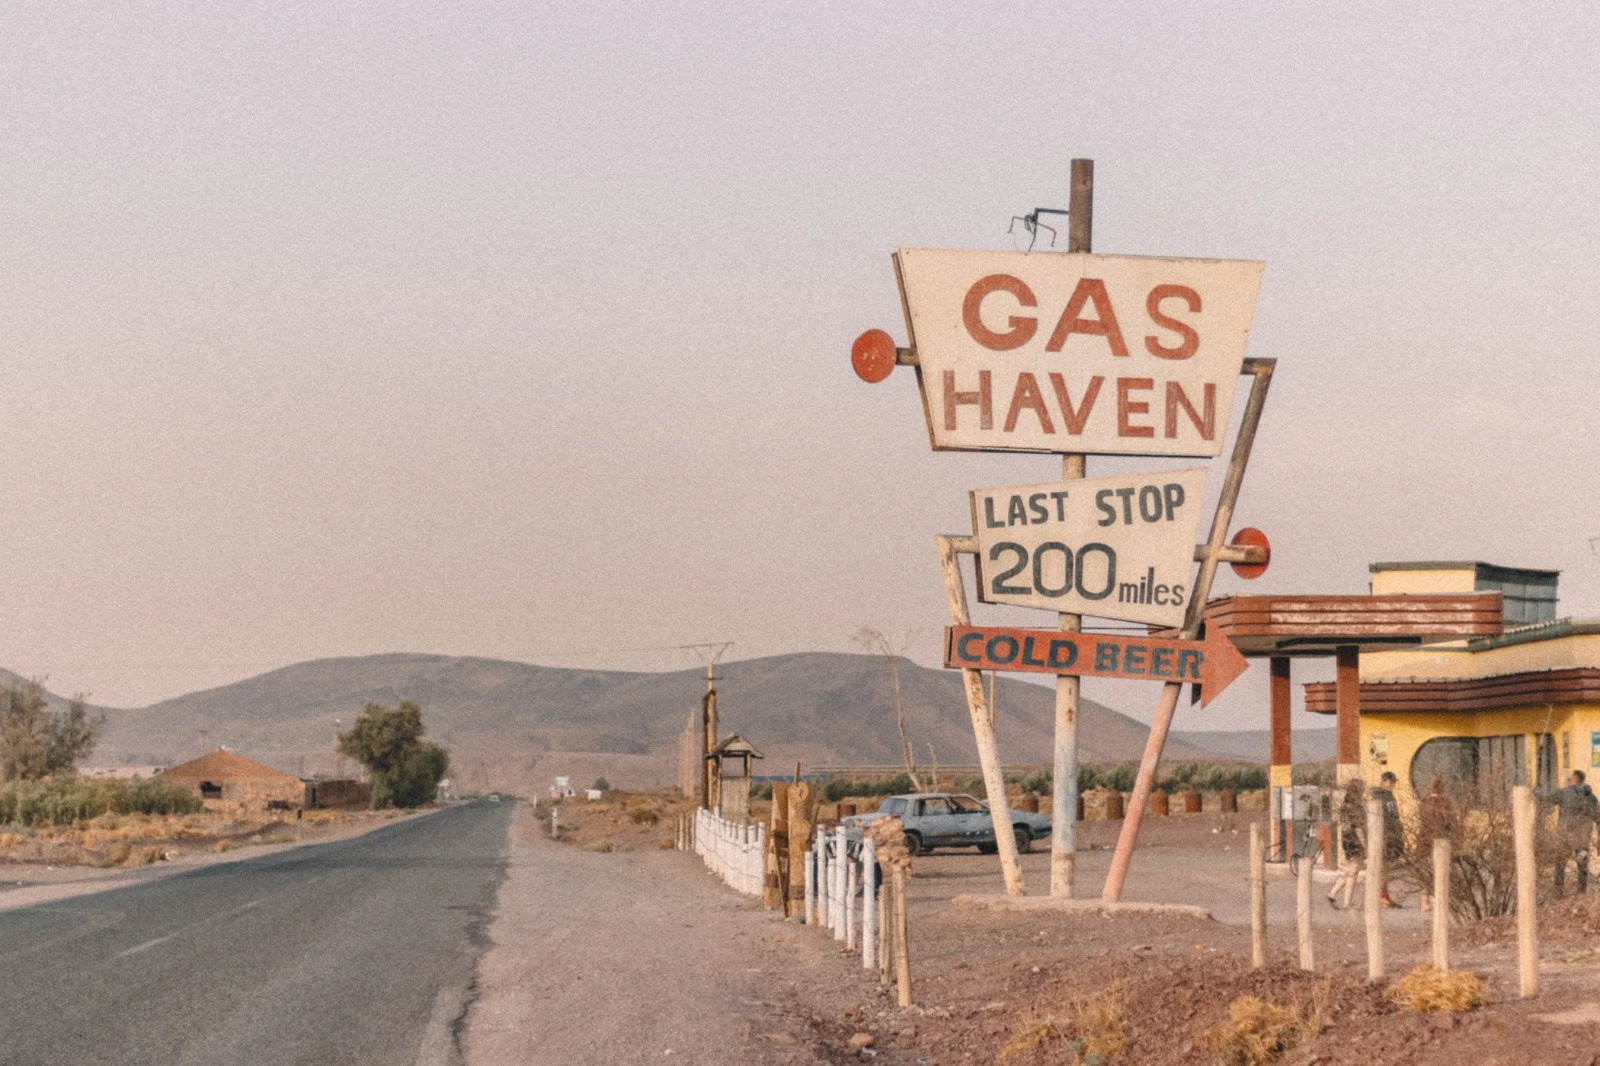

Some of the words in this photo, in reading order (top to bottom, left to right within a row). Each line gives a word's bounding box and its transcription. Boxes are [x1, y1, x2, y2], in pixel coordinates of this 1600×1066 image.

[963, 274, 1201, 360] GAS
[944, 370, 1216, 440] HAVEN
[985, 492, 1068, 528] LAST
[1095, 484, 1185, 527] STOP
[989, 542, 1116, 600] 200
[1119, 567, 1185, 606] miles
[956, 632, 1079, 669] COLD
[1094, 642, 1205, 679] BEER
